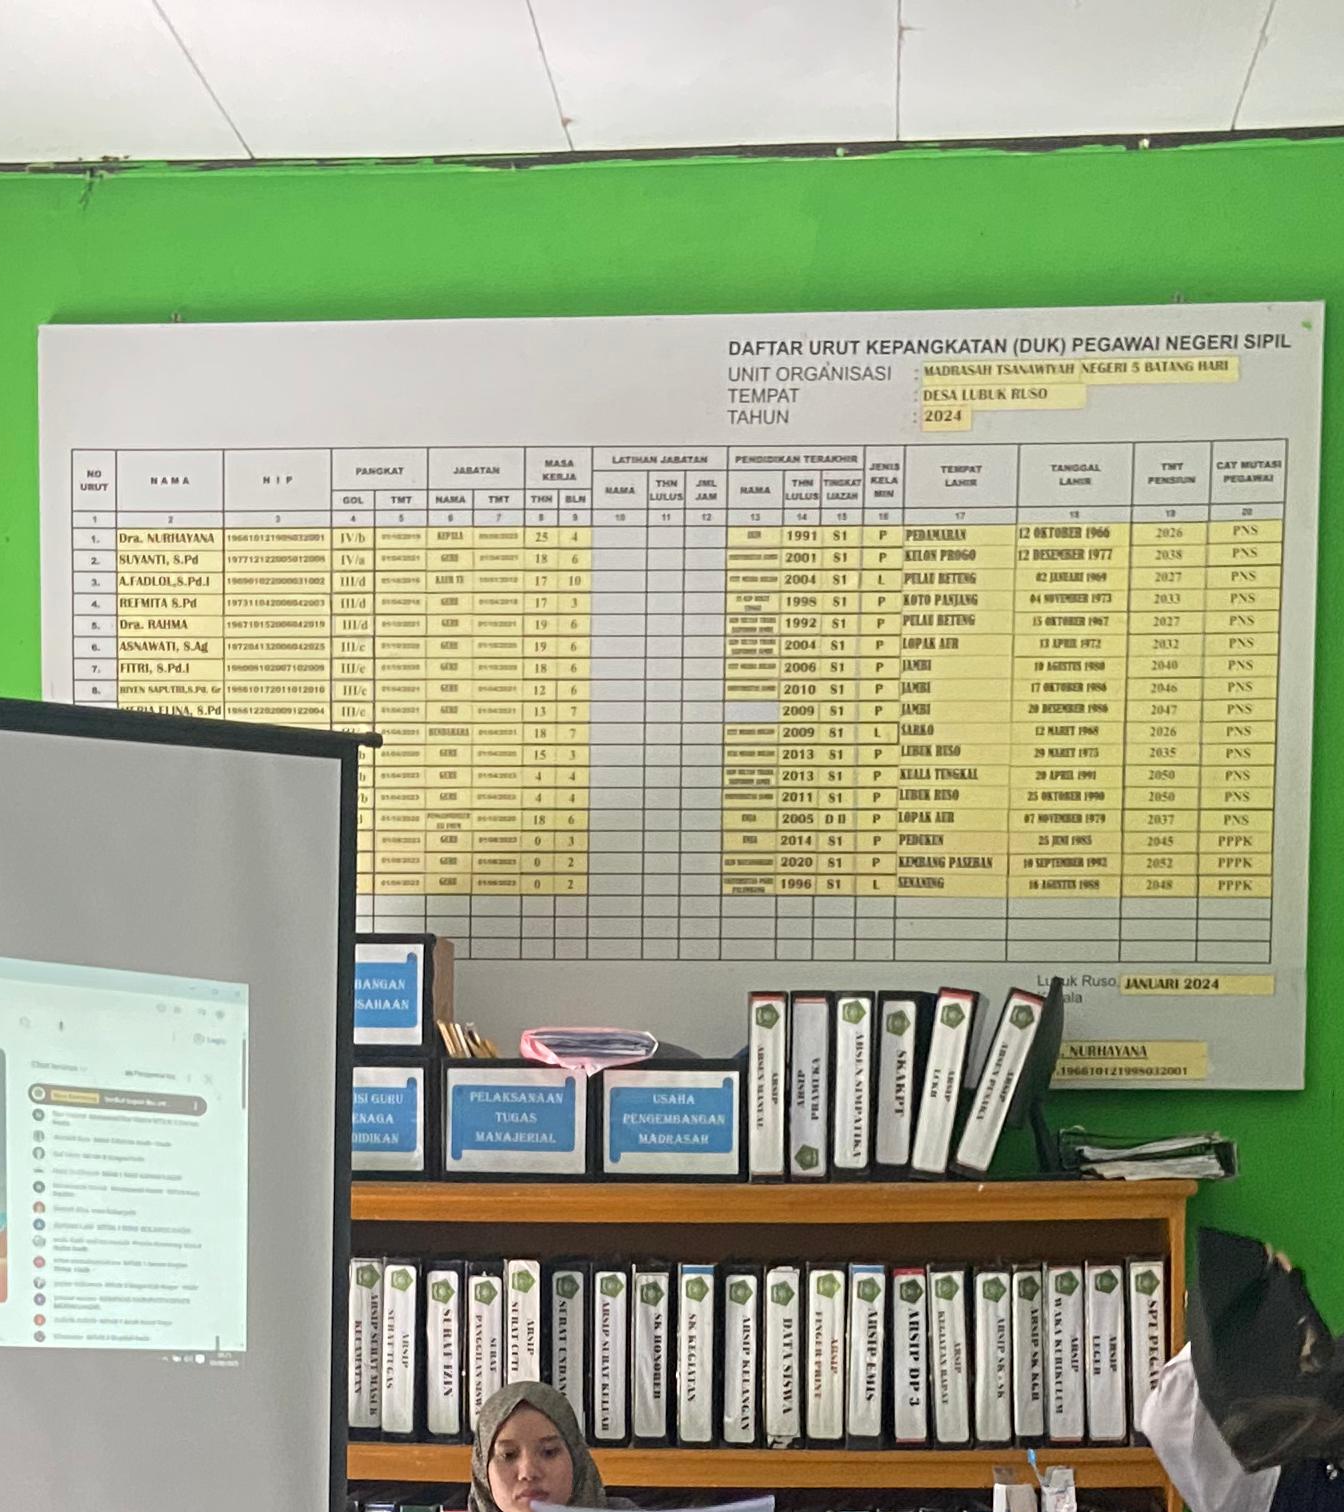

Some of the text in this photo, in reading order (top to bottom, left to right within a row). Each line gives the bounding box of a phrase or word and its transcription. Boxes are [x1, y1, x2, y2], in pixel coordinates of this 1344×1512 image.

[728, 333, 1292, 356] DAFTAR URUT KEPANGKATAN (DUK) PEGAWAI NEGERI SIPIL
[728, 365, 892, 383] UNIT ORGANISASI
[924, 359, 1229, 378] MADRASAH TSANAWIYAH NEGERI 5 BATANG HARI
[728, 386, 800, 404] TEMPAT
[923, 386, 1048, 402] DESA LUBUK RUSO
[728, 409, 790, 425] TAHUN
[924, 409, 962, 422] 2024
[545, 460, 574, 468] MASA
[869, 463, 900, 471] JENIS
[1050, 464, 1102, 474] TANGGAL
[87, 470, 102, 478] NO
[356, 467, 404, 475] PANGKAT
[453, 466, 500, 474] JABATAN
[940, 466, 982, 474] TEMPAT
[543, 473, 576, 481] KERJA
[80, 483, 108, 491] URUT
[787, 530, 817, 540] 1991
[1233, 526, 1258, 536] PNS
[119, 533, 214, 544] Dra. NURHAYANA
[119, 555, 198, 566] SUYANTI, S.Pd
[786, 552, 816, 562] 2001
[172, 598, 197, 608] S.Pd
[120, 620, 188, 630] Dra. RAHMA
[786, 618, 816, 628] 1992
[120, 641, 208, 653] ASNAWATI, S.Ag
[120, 664, 153, 674] FITRI,
[782, 749, 814, 759] 2013
[1218, 836, 1252, 847] PPPK
[1125, 979, 1219, 990] JANUARI 2024
[1069, 1046, 1147, 1057] NURHAYANA
[371, 1093, 403, 1104] GURU
[470, 1092, 563, 1103] PELAKSANAAN
[653, 1095, 695, 1105] USAHA
[495, 1112, 537, 1123] TUGAS
[623, 1112, 725, 1124] PENGEMBANGAN
[475, 1131, 556, 1143] MANAJERIAL
[638, 1133, 709, 1144] MADRASAH
[867, 1309, 877, 1360] ARSIP
[908, 1308, 919, 1364] ARSIP
[443, 1309, 453, 1397] SURAT IZIN
[783, 1318, 792, 1414] DATA SISWA
[909, 1368, 920, 1392] DP
